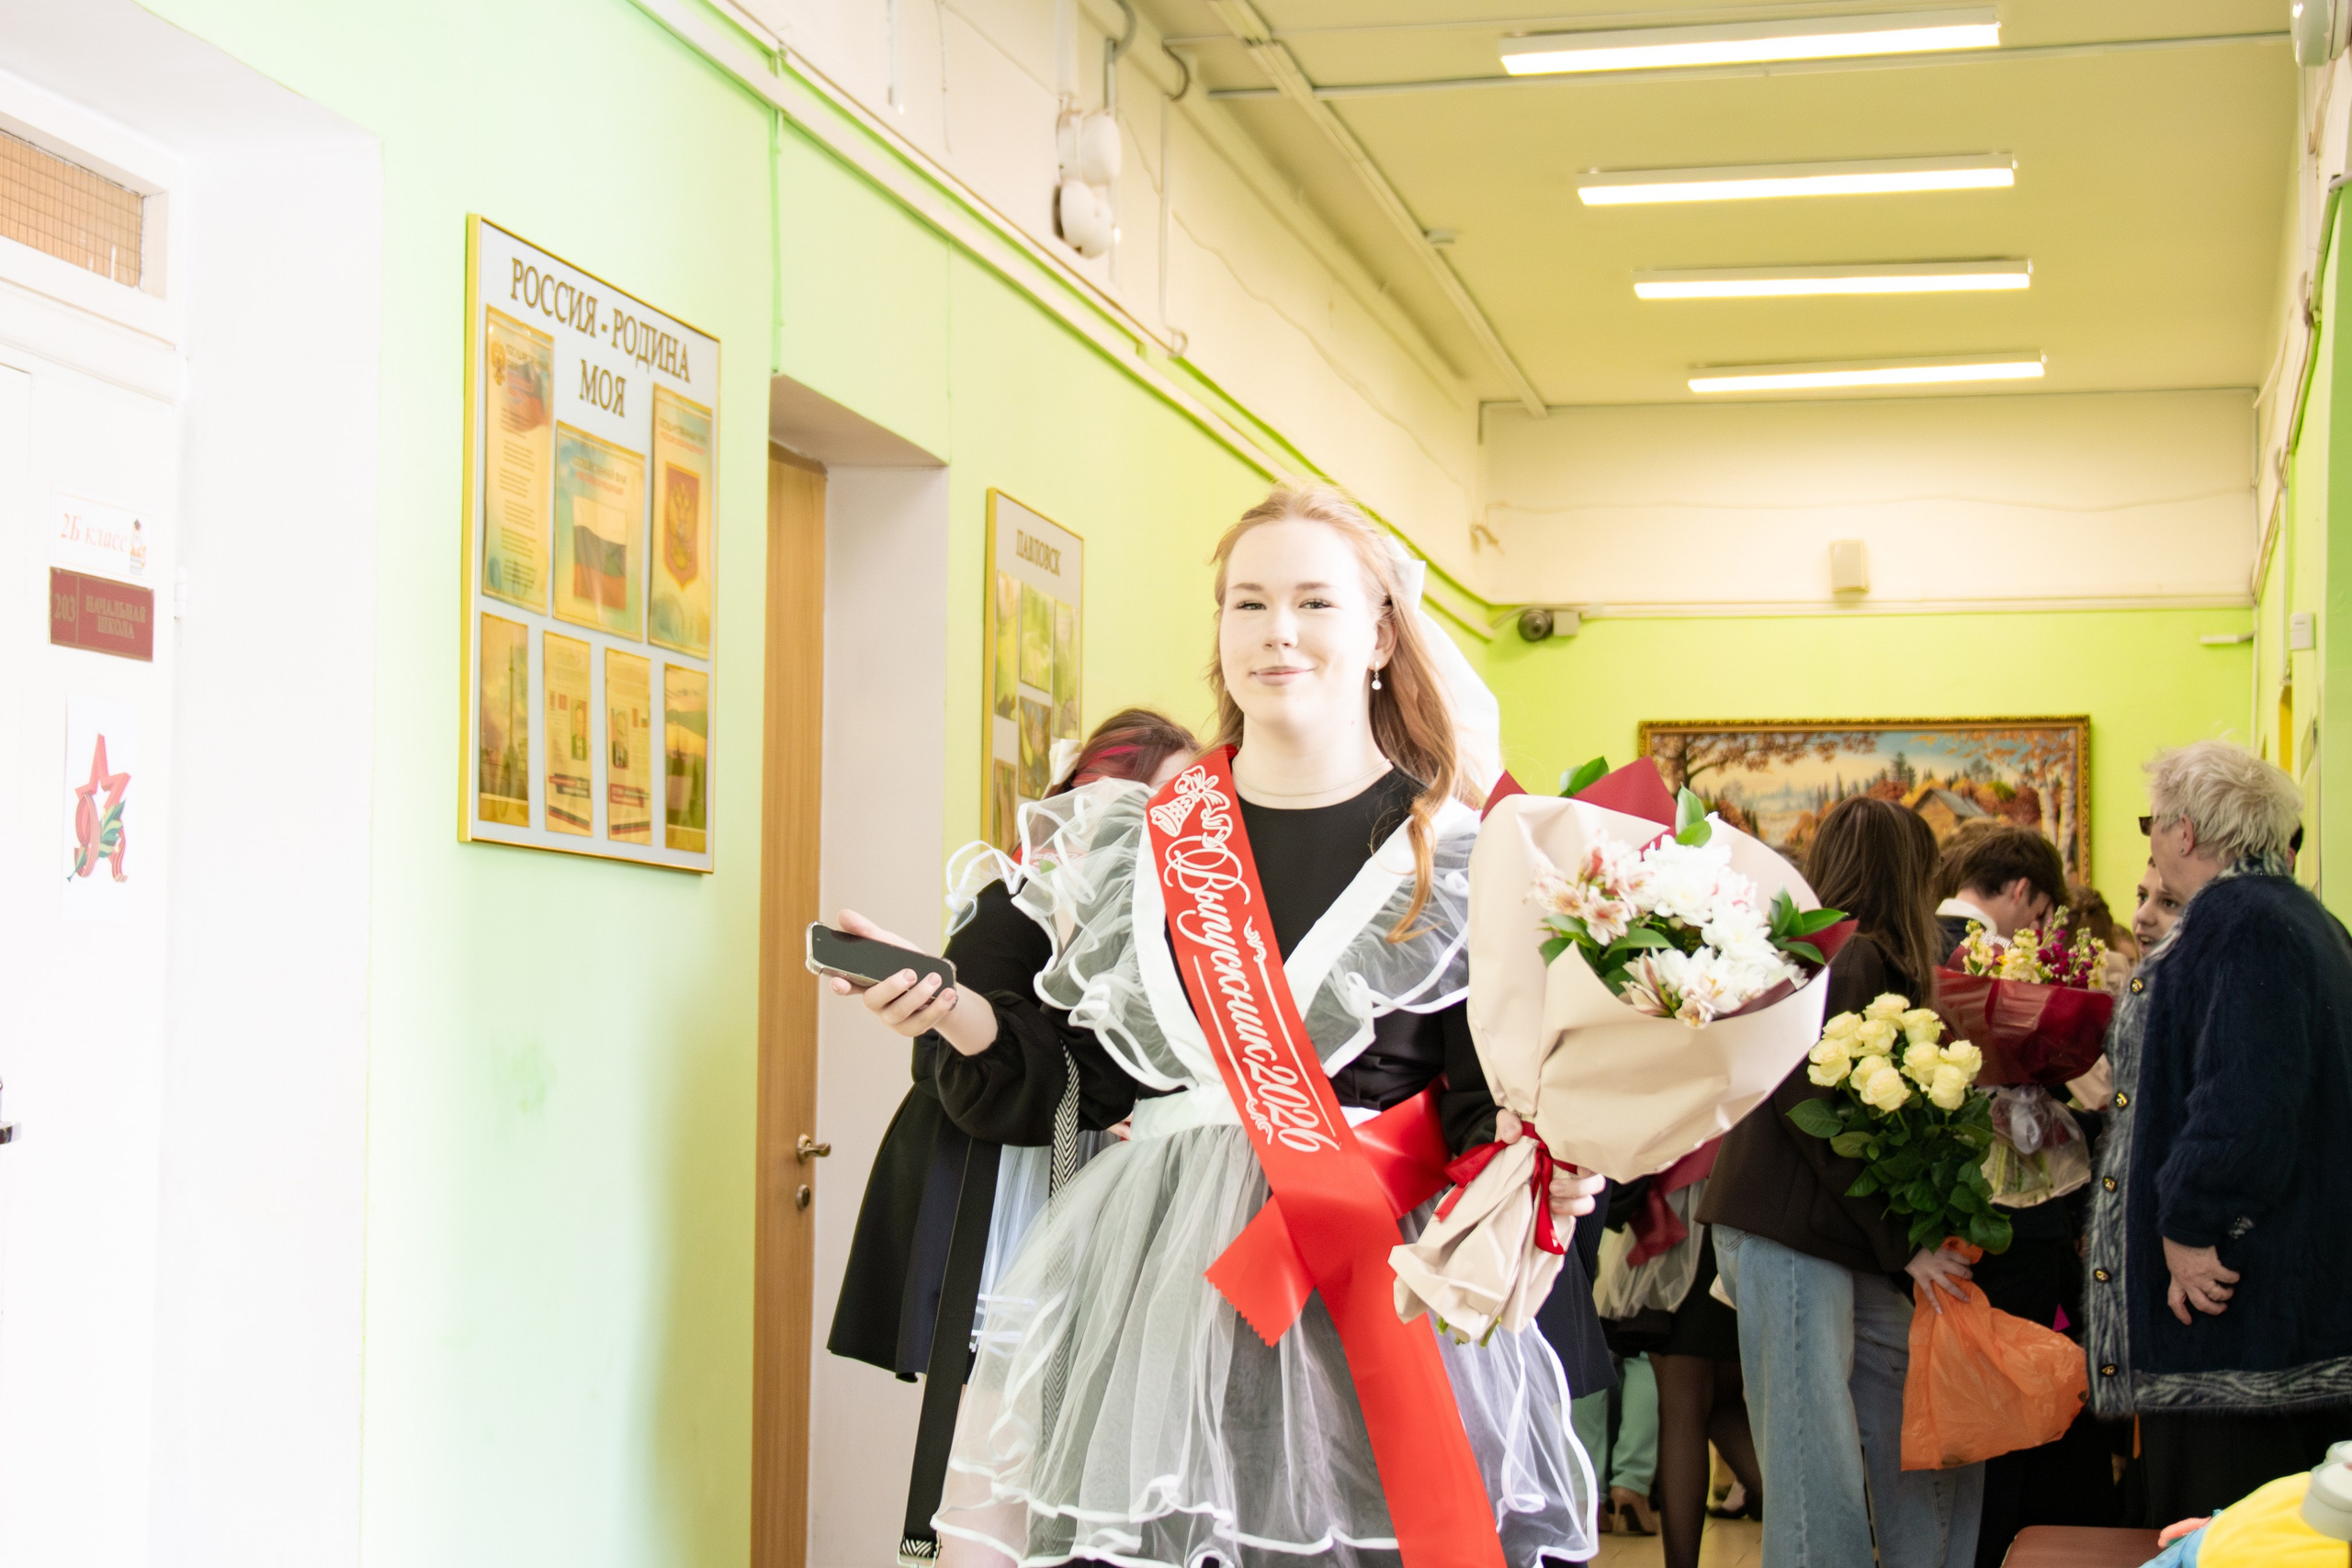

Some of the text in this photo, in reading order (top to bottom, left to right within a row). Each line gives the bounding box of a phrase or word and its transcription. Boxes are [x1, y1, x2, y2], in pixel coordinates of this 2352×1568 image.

[511, 256, 598, 338] РОССИЯ
[612, 308, 692, 384] РОДИНА
[579, 358, 627, 418] МОЯ
[60, 513, 128, 553] 2Б класс
[1015, 528, 1062, 577] ПАВЛОВСК
[85, 594, 147, 624] НАЧАЛЬНАЯ
[96, 615, 136, 640] ШКОЛА
[1163, 834, 1341, 1152] Выпускник 2026
